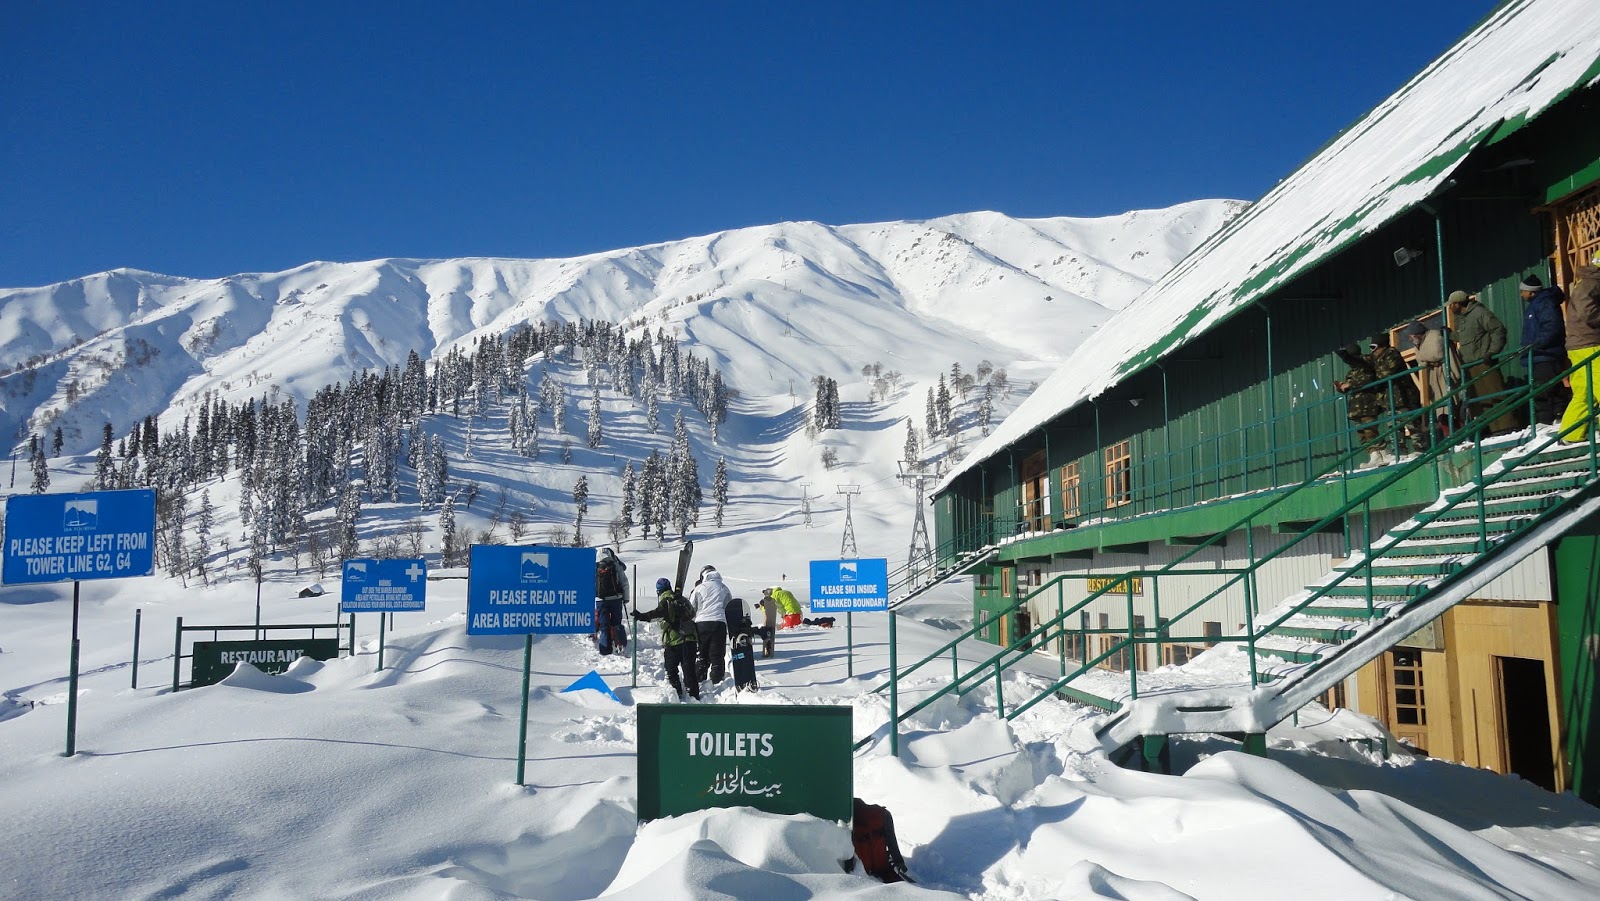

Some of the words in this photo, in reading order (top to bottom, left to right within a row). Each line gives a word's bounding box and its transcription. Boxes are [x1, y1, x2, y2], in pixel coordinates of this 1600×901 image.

[11, 537, 52, 556] PLEASE
[55, 535, 85, 554] KEEP
[87, 534, 114, 552] LEFT
[117, 532, 147, 551] FROM
[26, 556, 65, 576] TOWER
[68, 555, 93, 573] LINE
[96, 554, 113, 574] G2,
[116, 552, 131, 570] G4
[489, 589, 527, 605] PLEASE
[530, 590, 556, 605] READ
[558, 590, 577, 604] THE
[820, 585, 844, 595] PLEASE
[845, 585, 856, 594] SKI
[857, 584, 877, 594] INSIDE
[812, 598, 825, 608] THE
[826, 598, 852, 608] MARKED
[853, 597, 887, 608] BOUNDARY
[472, 613, 501, 629] AREA
[503, 612, 542, 628] BEFORE
[544, 612, 591, 627] STARTING
[221, 649, 304, 664] RESTAURANT
[686, 732, 774, 757] TOILETS
